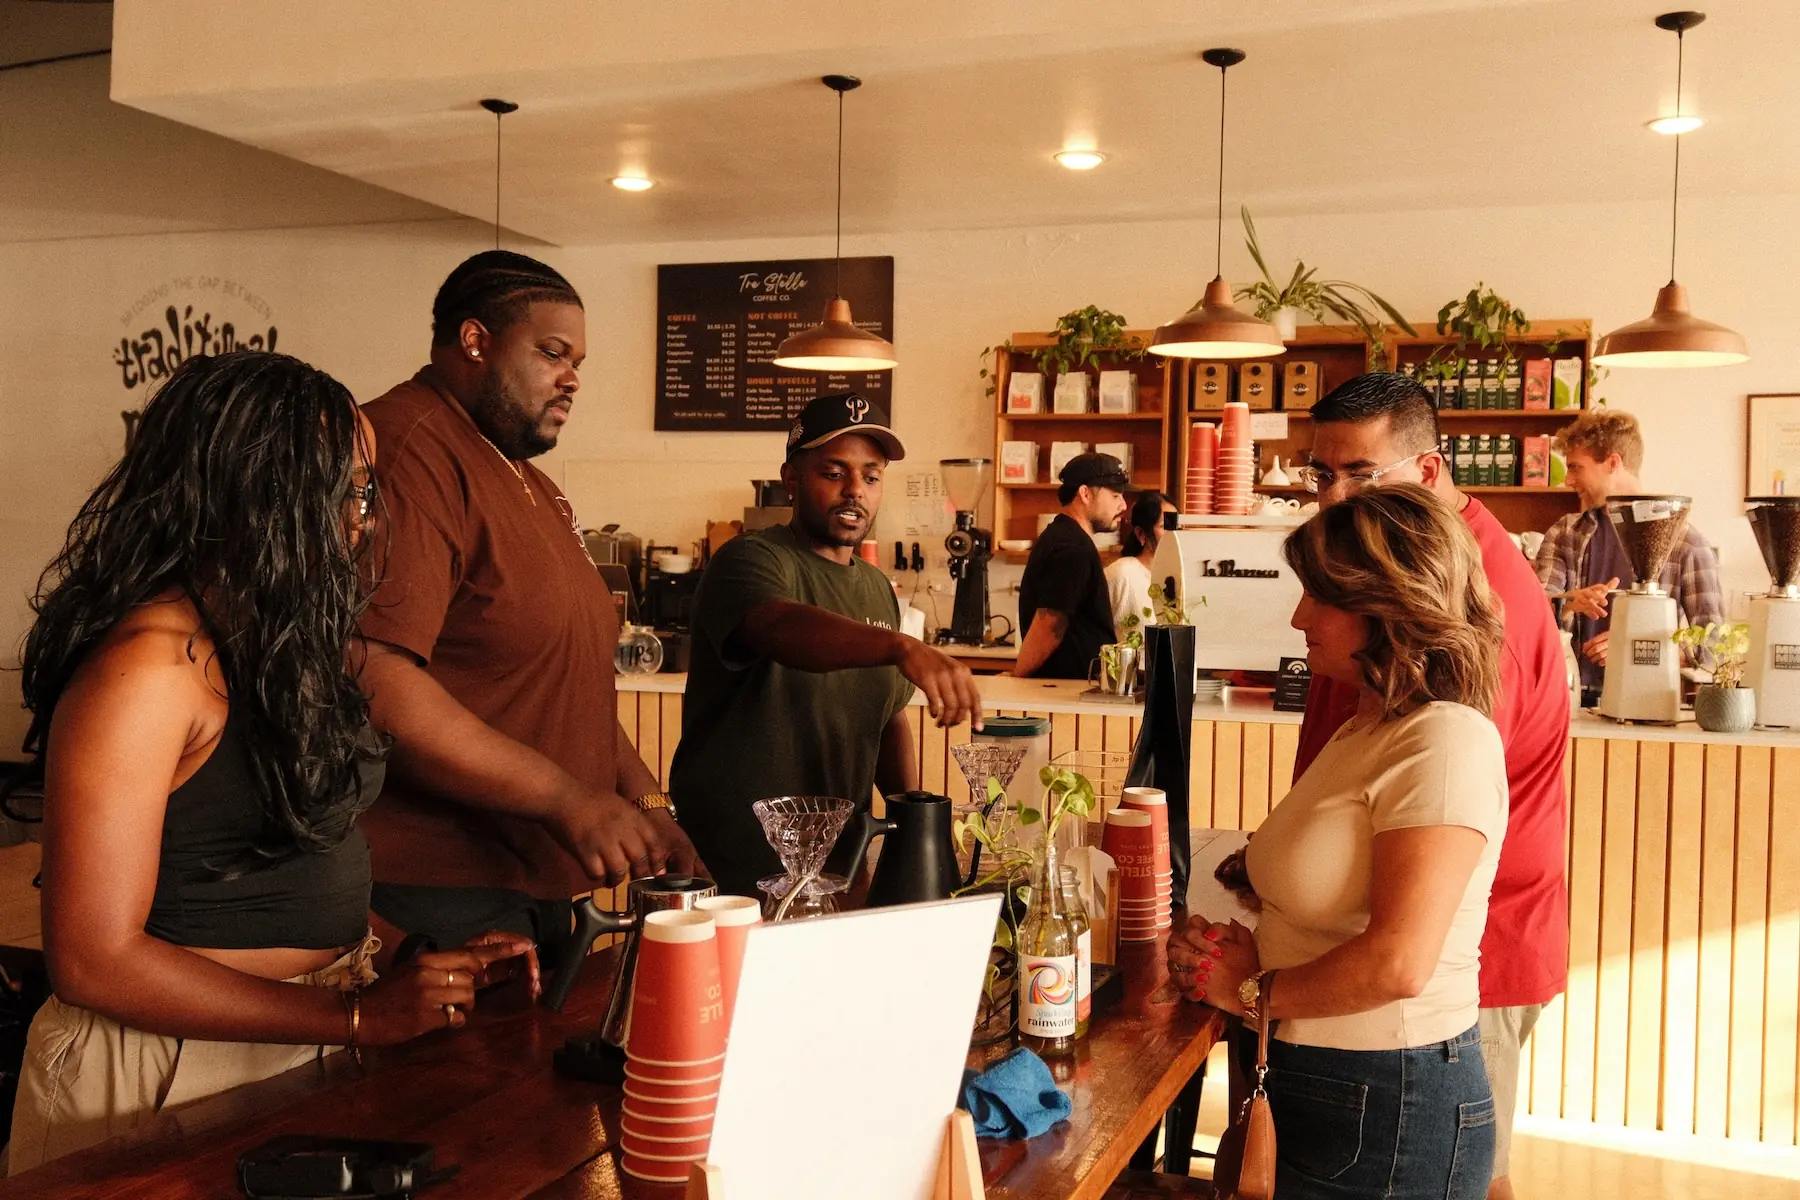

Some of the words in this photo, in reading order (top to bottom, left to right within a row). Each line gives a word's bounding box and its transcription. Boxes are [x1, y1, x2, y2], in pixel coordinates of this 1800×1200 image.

[173, 276, 194, 290] THE
[198, 275, 220, 288] GAP
[739, 272, 760, 293] Tre
[763, 271, 808, 294] Stelle
[667, 314, 697, 322] COFFEE
[620, 645, 654, 666] TIPS
[1119, 865, 1152, 877] STELL
